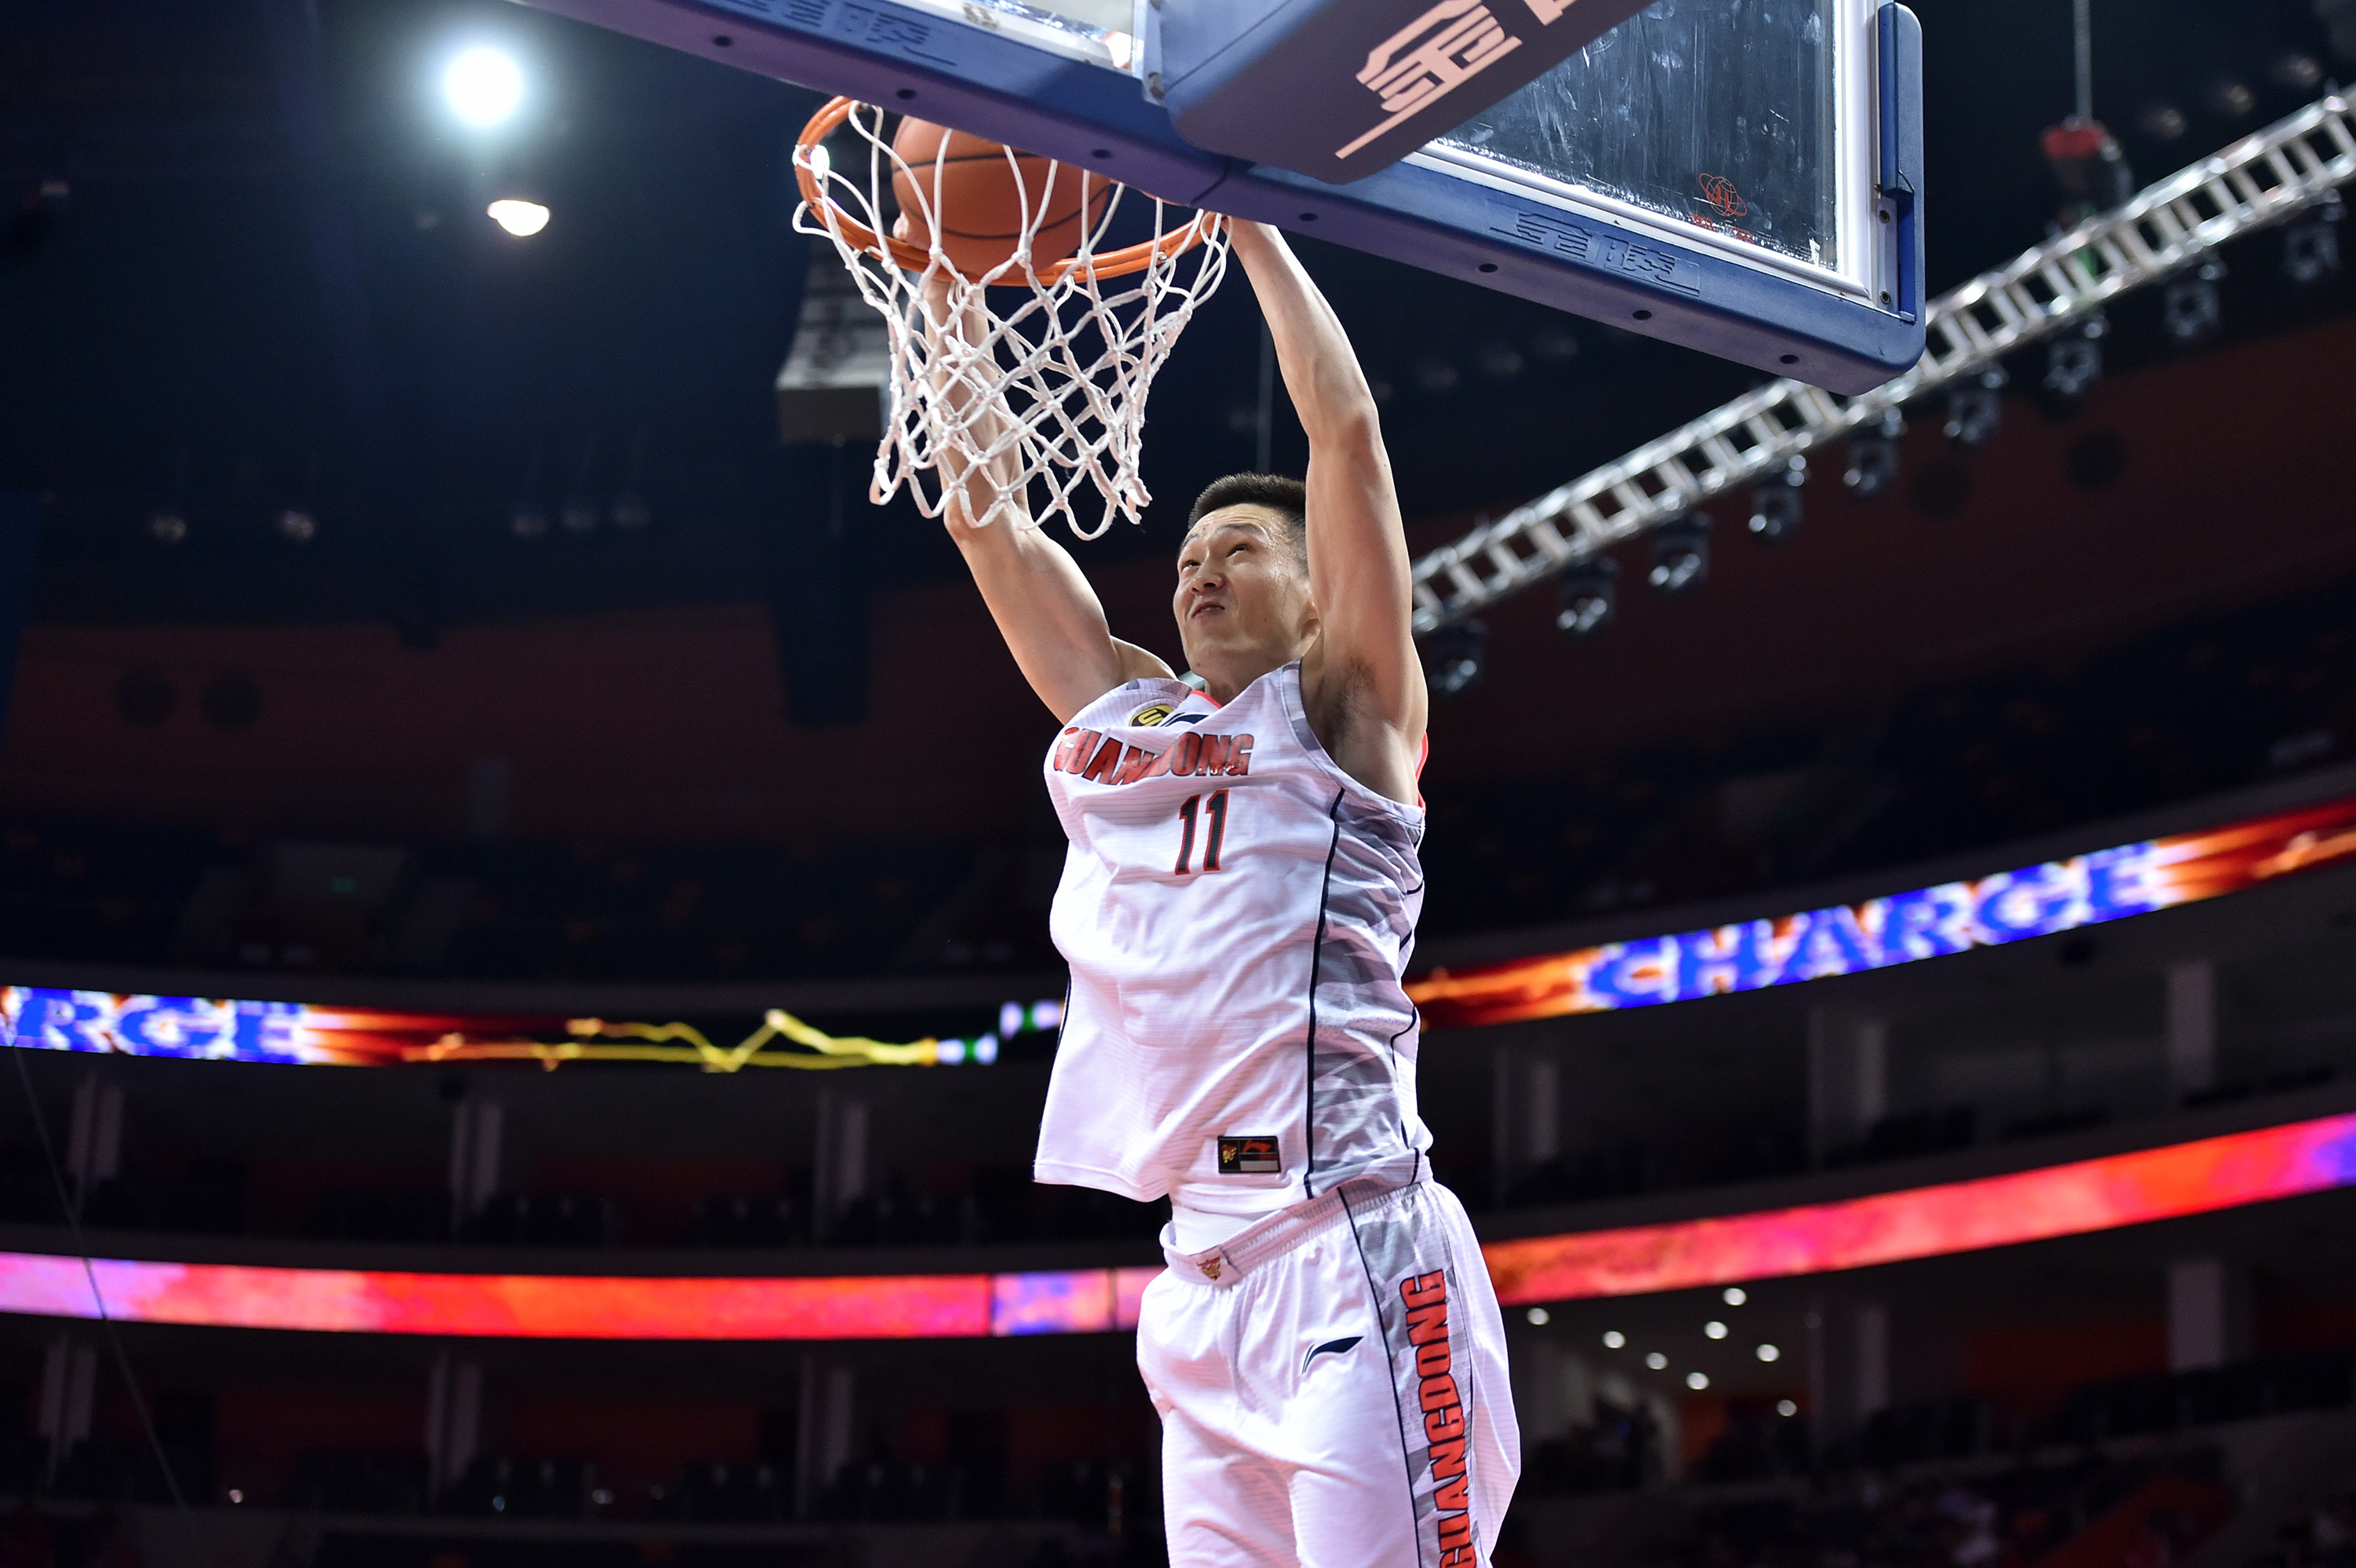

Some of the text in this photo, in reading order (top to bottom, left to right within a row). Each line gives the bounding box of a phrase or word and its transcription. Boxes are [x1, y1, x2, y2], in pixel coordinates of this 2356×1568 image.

[1335, 0, 1577, 159] 金
[1053, 726, 1254, 786] GUANONG
[1175, 789, 1230, 875] 11
[1586, 842, 2165, 1010] CHARGE
[0, 986, 305, 1065] RGE
[1399, 1269, 1477, 1568] GUANGDONG
